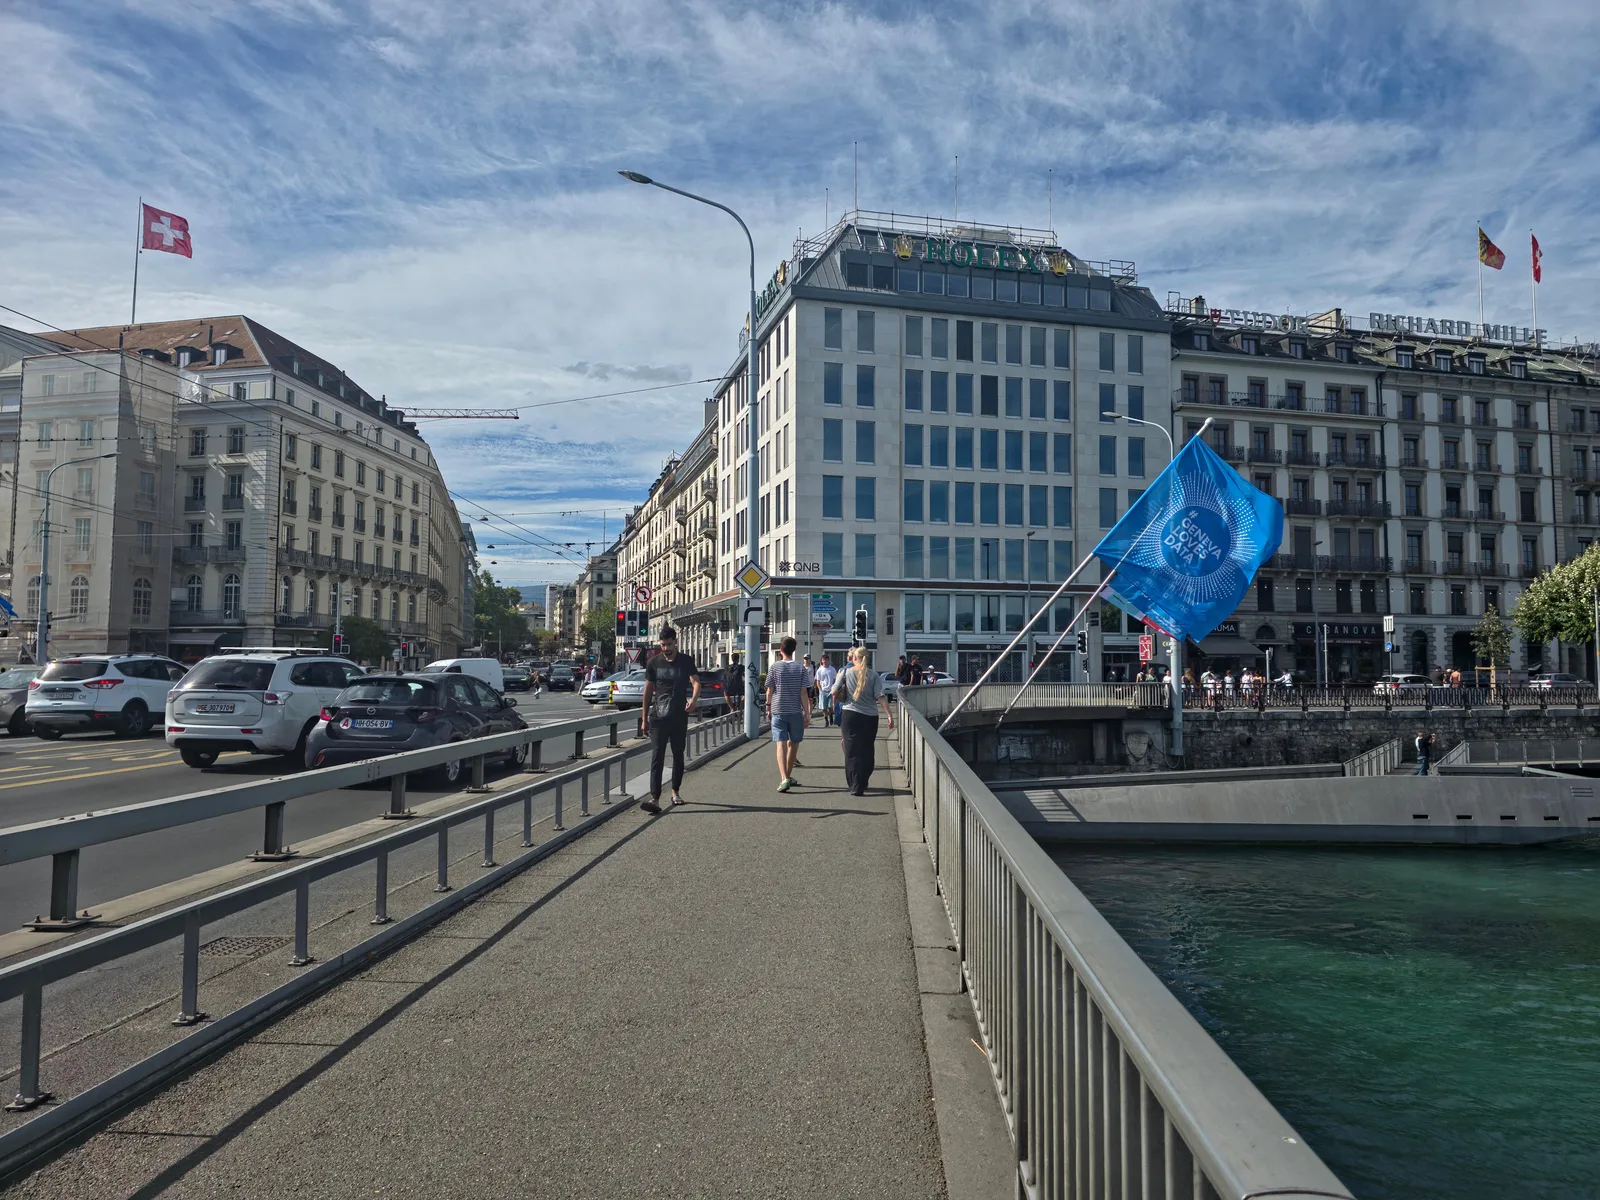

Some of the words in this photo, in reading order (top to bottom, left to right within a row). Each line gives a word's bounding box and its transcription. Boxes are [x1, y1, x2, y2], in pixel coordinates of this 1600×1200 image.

[925, 239, 1042, 272] ROLEX
[755, 270, 779, 318] OLEX
[1225, 309, 1311, 335] TUDOR
[1370, 312, 1471, 336] RICHARD
[1483, 323, 1547, 344] MILLE
[1188, 510, 1199, 519] #
[1164, 534, 1194, 564] DATA
[1172, 525, 1209, 559] LOVES
[1182, 518, 1221, 560] GENEVA
[793, 562, 820, 572] QNB
[342, 720, 349, 728] A
